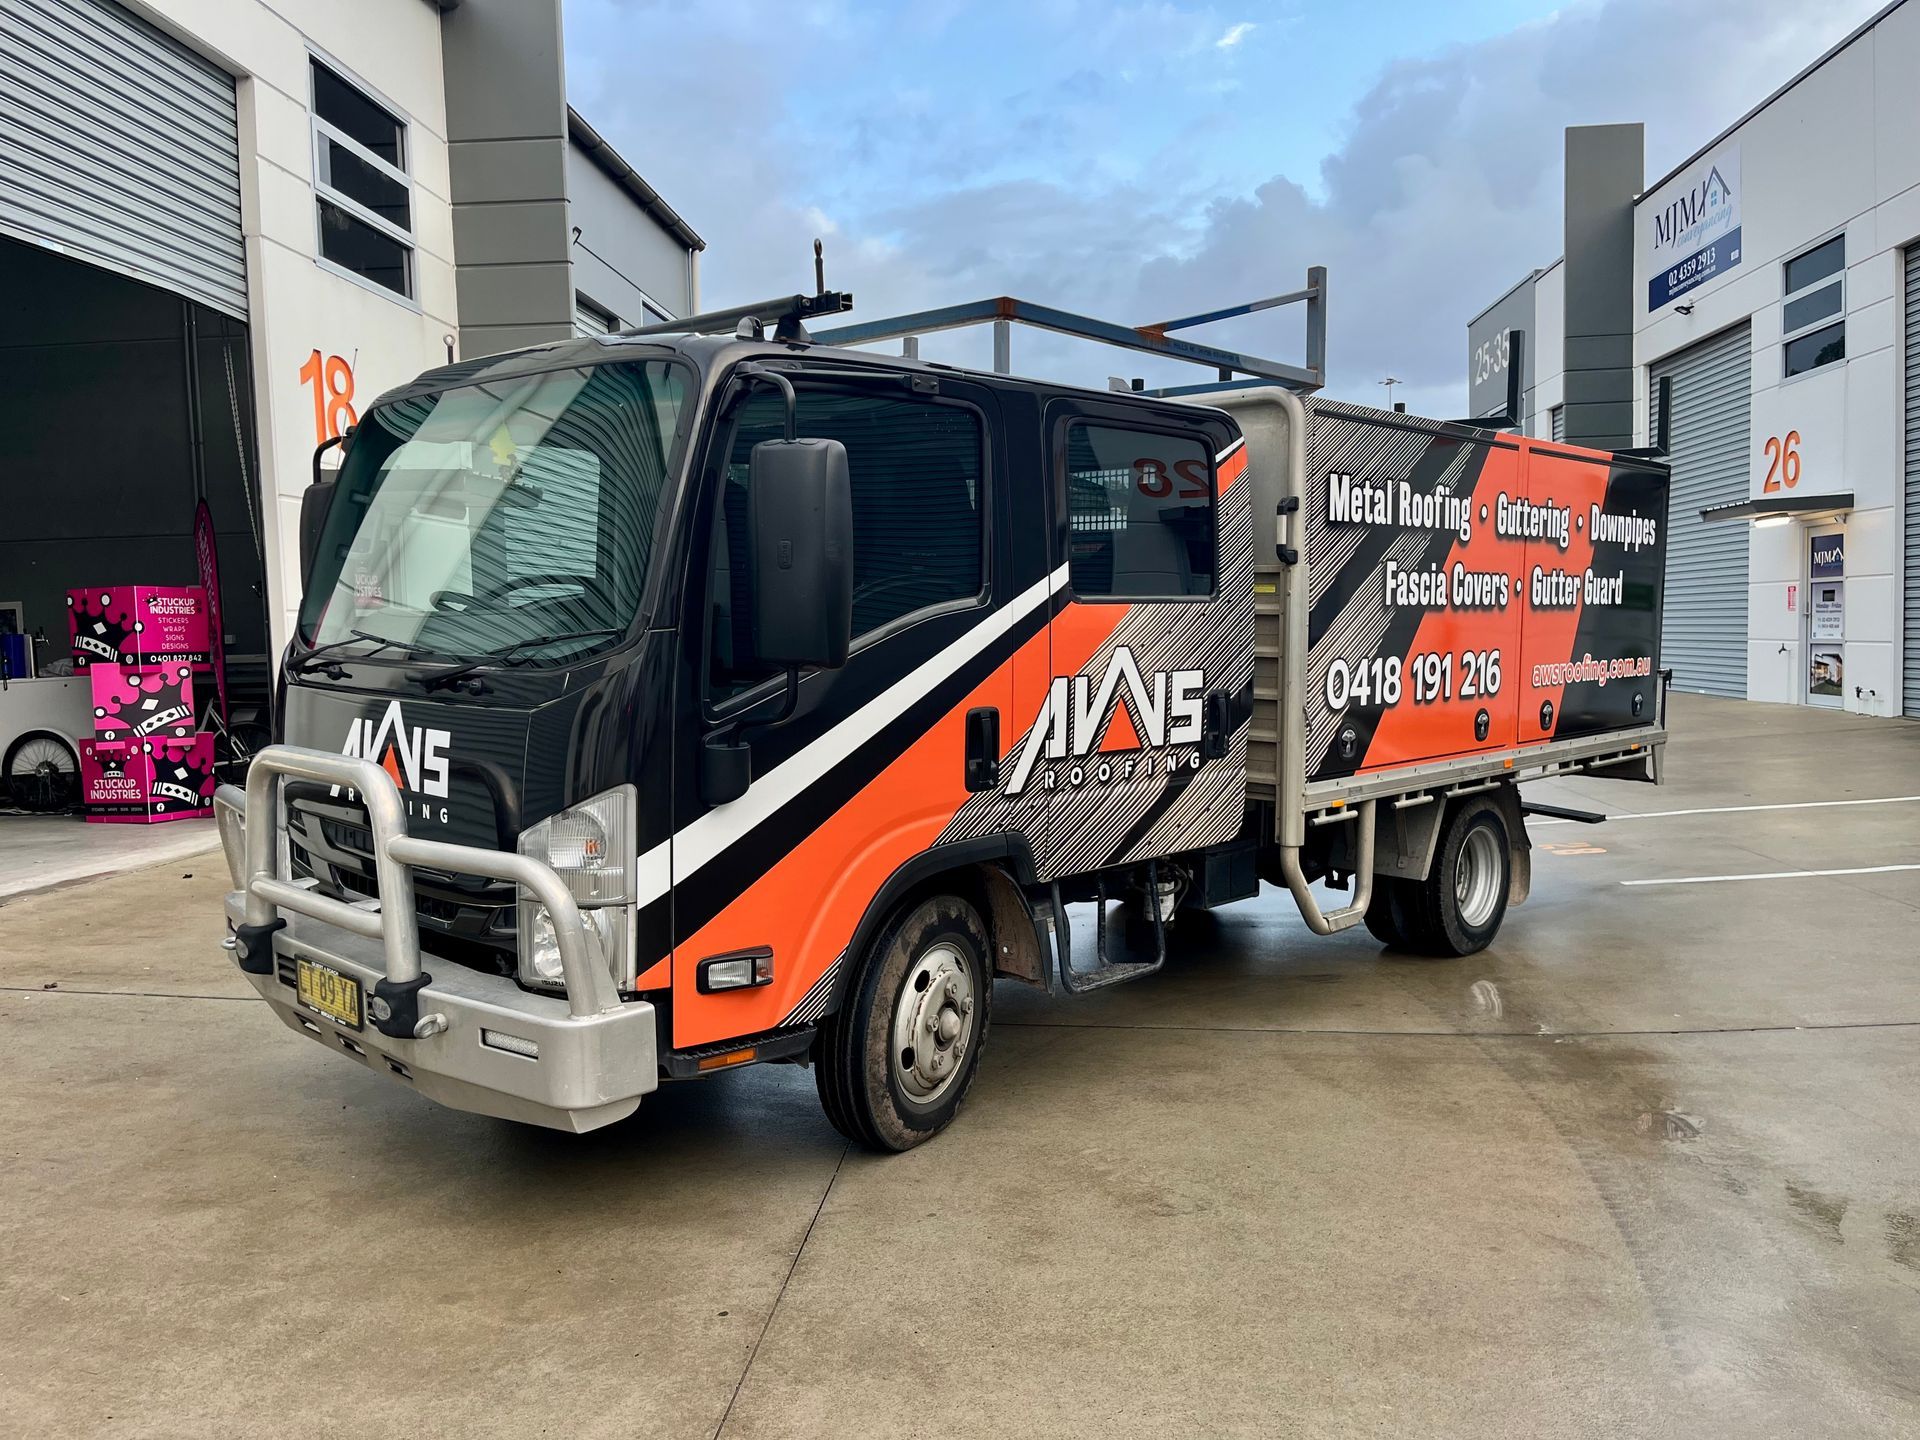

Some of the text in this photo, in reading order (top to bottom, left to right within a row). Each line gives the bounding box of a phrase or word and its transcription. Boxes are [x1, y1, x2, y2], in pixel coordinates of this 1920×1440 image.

[1654, 188, 1697, 249] MJM
[1668, 269, 1678, 287] 02
[1678, 258, 1697, 280] 4359
[1697, 247, 1716, 271] 2913
[299, 348, 359, 449] 18
[1763, 430, 1801, 494] 26
[1329, 473, 1656, 552] Metal Roofing Guttering Downpipes
[157, 597, 195, 606] STUCKUP
[1386, 561, 1624, 607] Fascia Covers Gutter Guard
[149, 606, 195, 614] INDUSTRIES
[150, 654, 171, 662] 0401
[173, 654, 187, 662] 827
[161, 642, 189, 650] DESIGNS
[1327, 649, 1651, 710] 0418 191 216 awsroofing.com.au
[1004, 645, 1204, 796] AWS
[93, 779, 136, 789] STUCKUP
[1044, 751, 1200, 789] ROOFING
[90, 789, 142, 799] INDUSTRIES
[348, 787, 448, 823] RING
